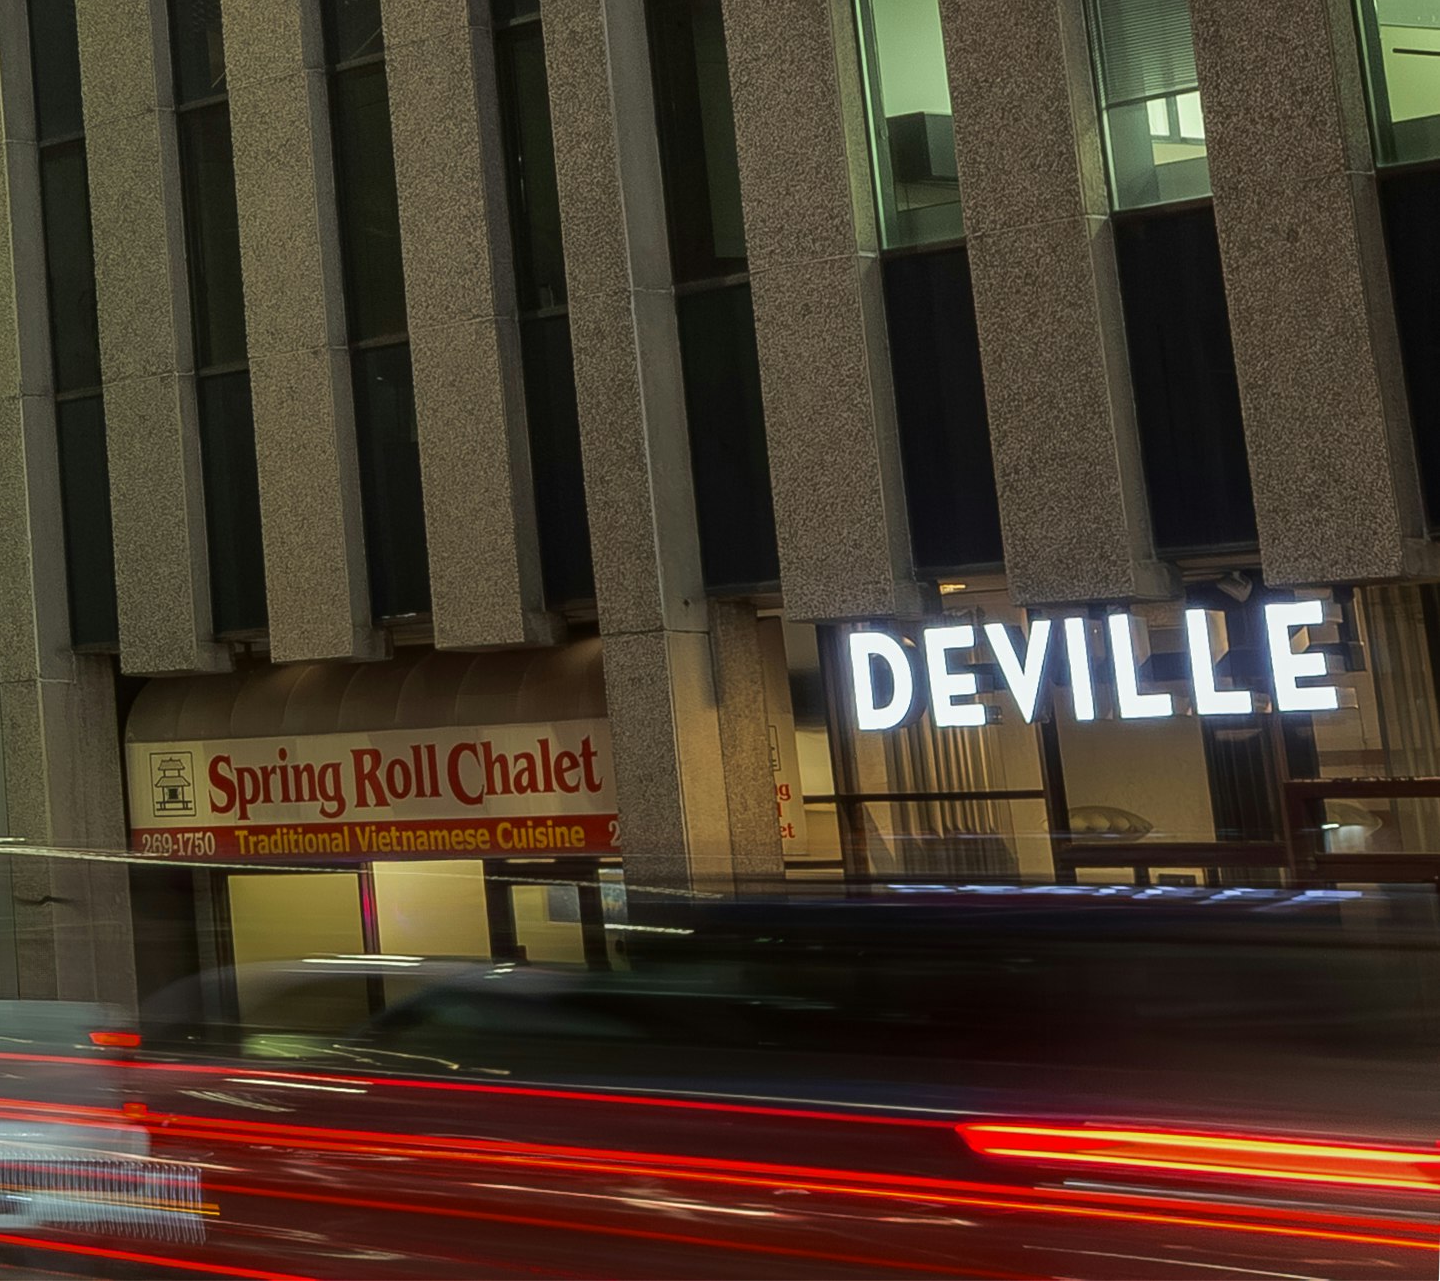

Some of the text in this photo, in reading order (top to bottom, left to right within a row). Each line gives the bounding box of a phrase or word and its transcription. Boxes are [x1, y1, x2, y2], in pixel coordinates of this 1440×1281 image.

[848, 599, 1340, 731] DEVILLE
[207, 734, 605, 821] Spring Roll Chalet
[141, 831, 216, 857] 269-1750
[234, 825, 351, 855] Traditional
[355, 824, 491, 852] Vietnamese
[496, 819, 586, 850] Cuisine
